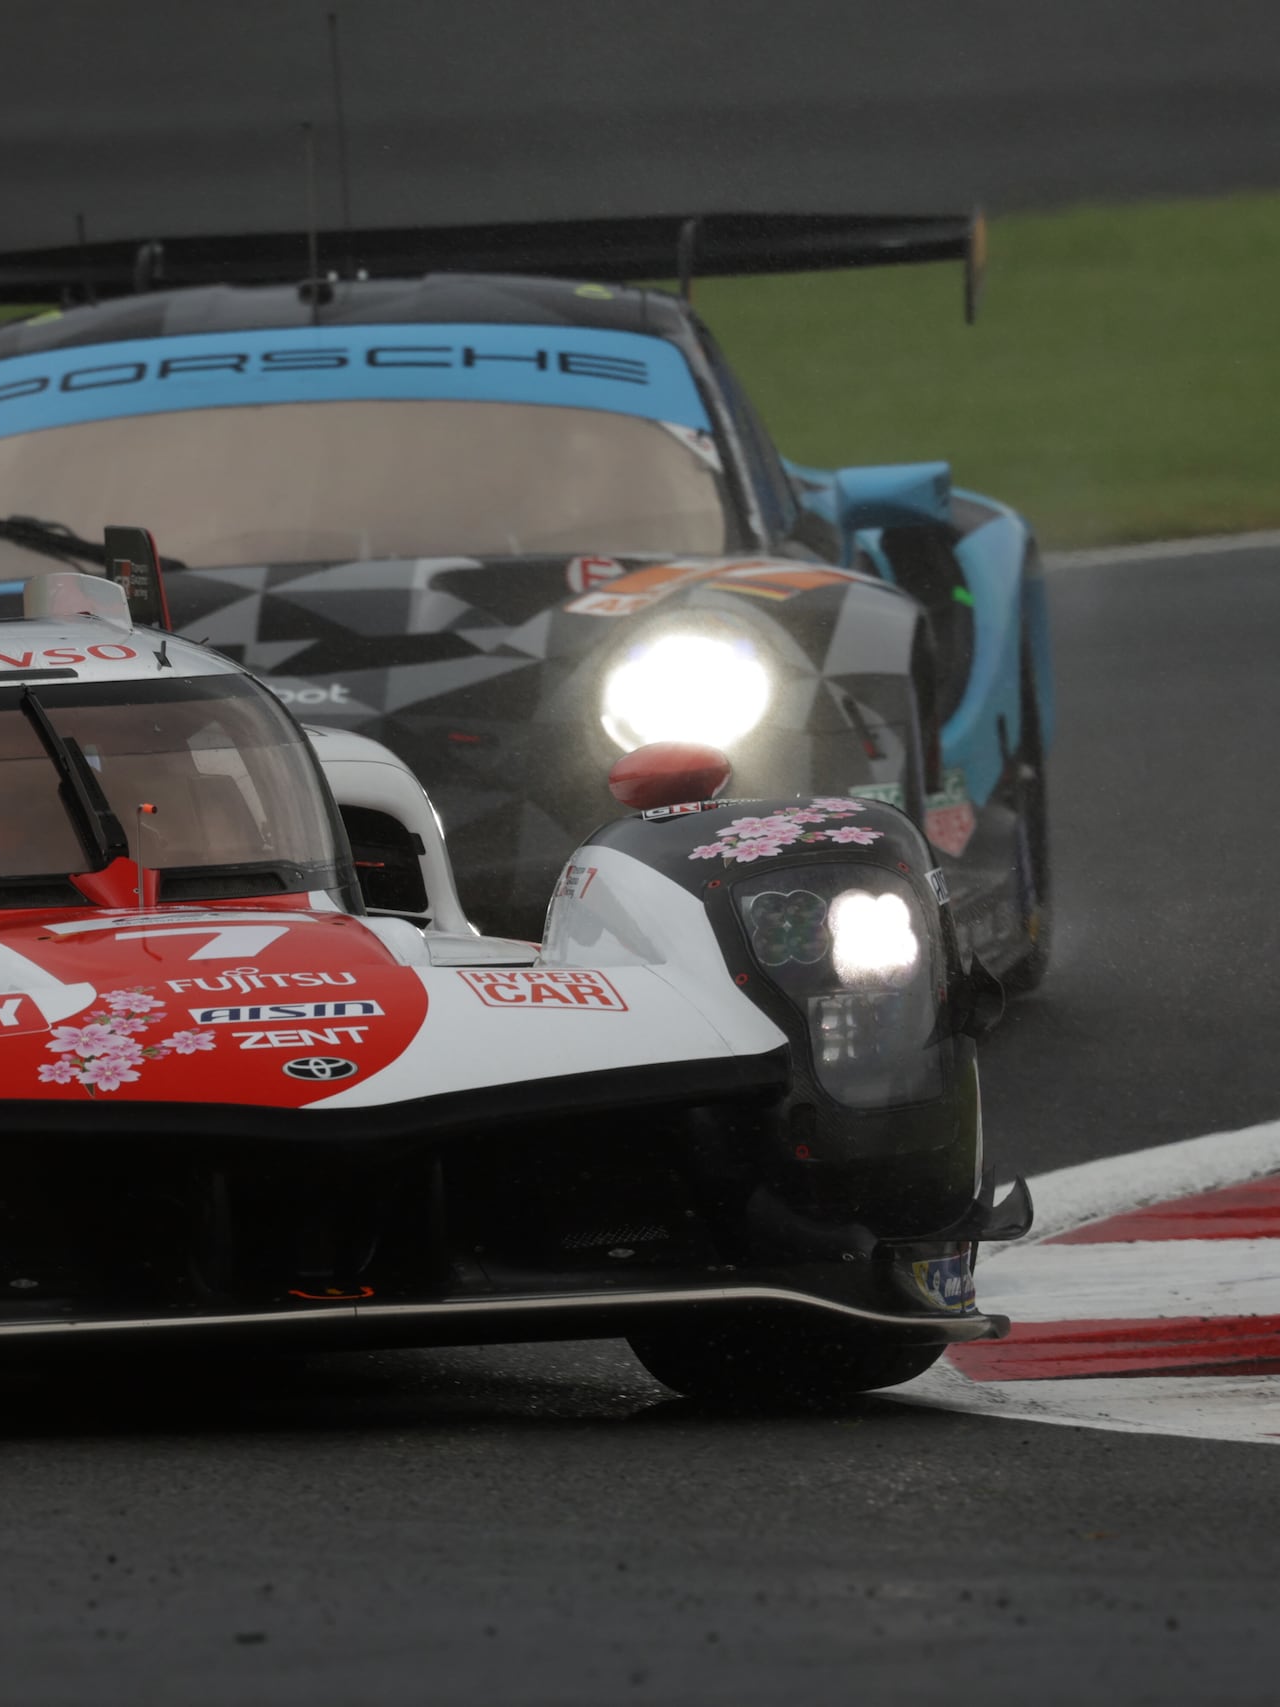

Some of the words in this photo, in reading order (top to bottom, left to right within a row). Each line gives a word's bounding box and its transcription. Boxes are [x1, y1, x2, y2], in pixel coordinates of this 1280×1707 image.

[115, 925, 291, 961] 7
[166, 969, 357, 995] FUJITSU
[471, 971, 597, 984] HYPER
[482, 983, 615, 1007] CAR
[200, 1001, 375, 1022] AISIN
[231, 1026, 370, 1050] ZENT
